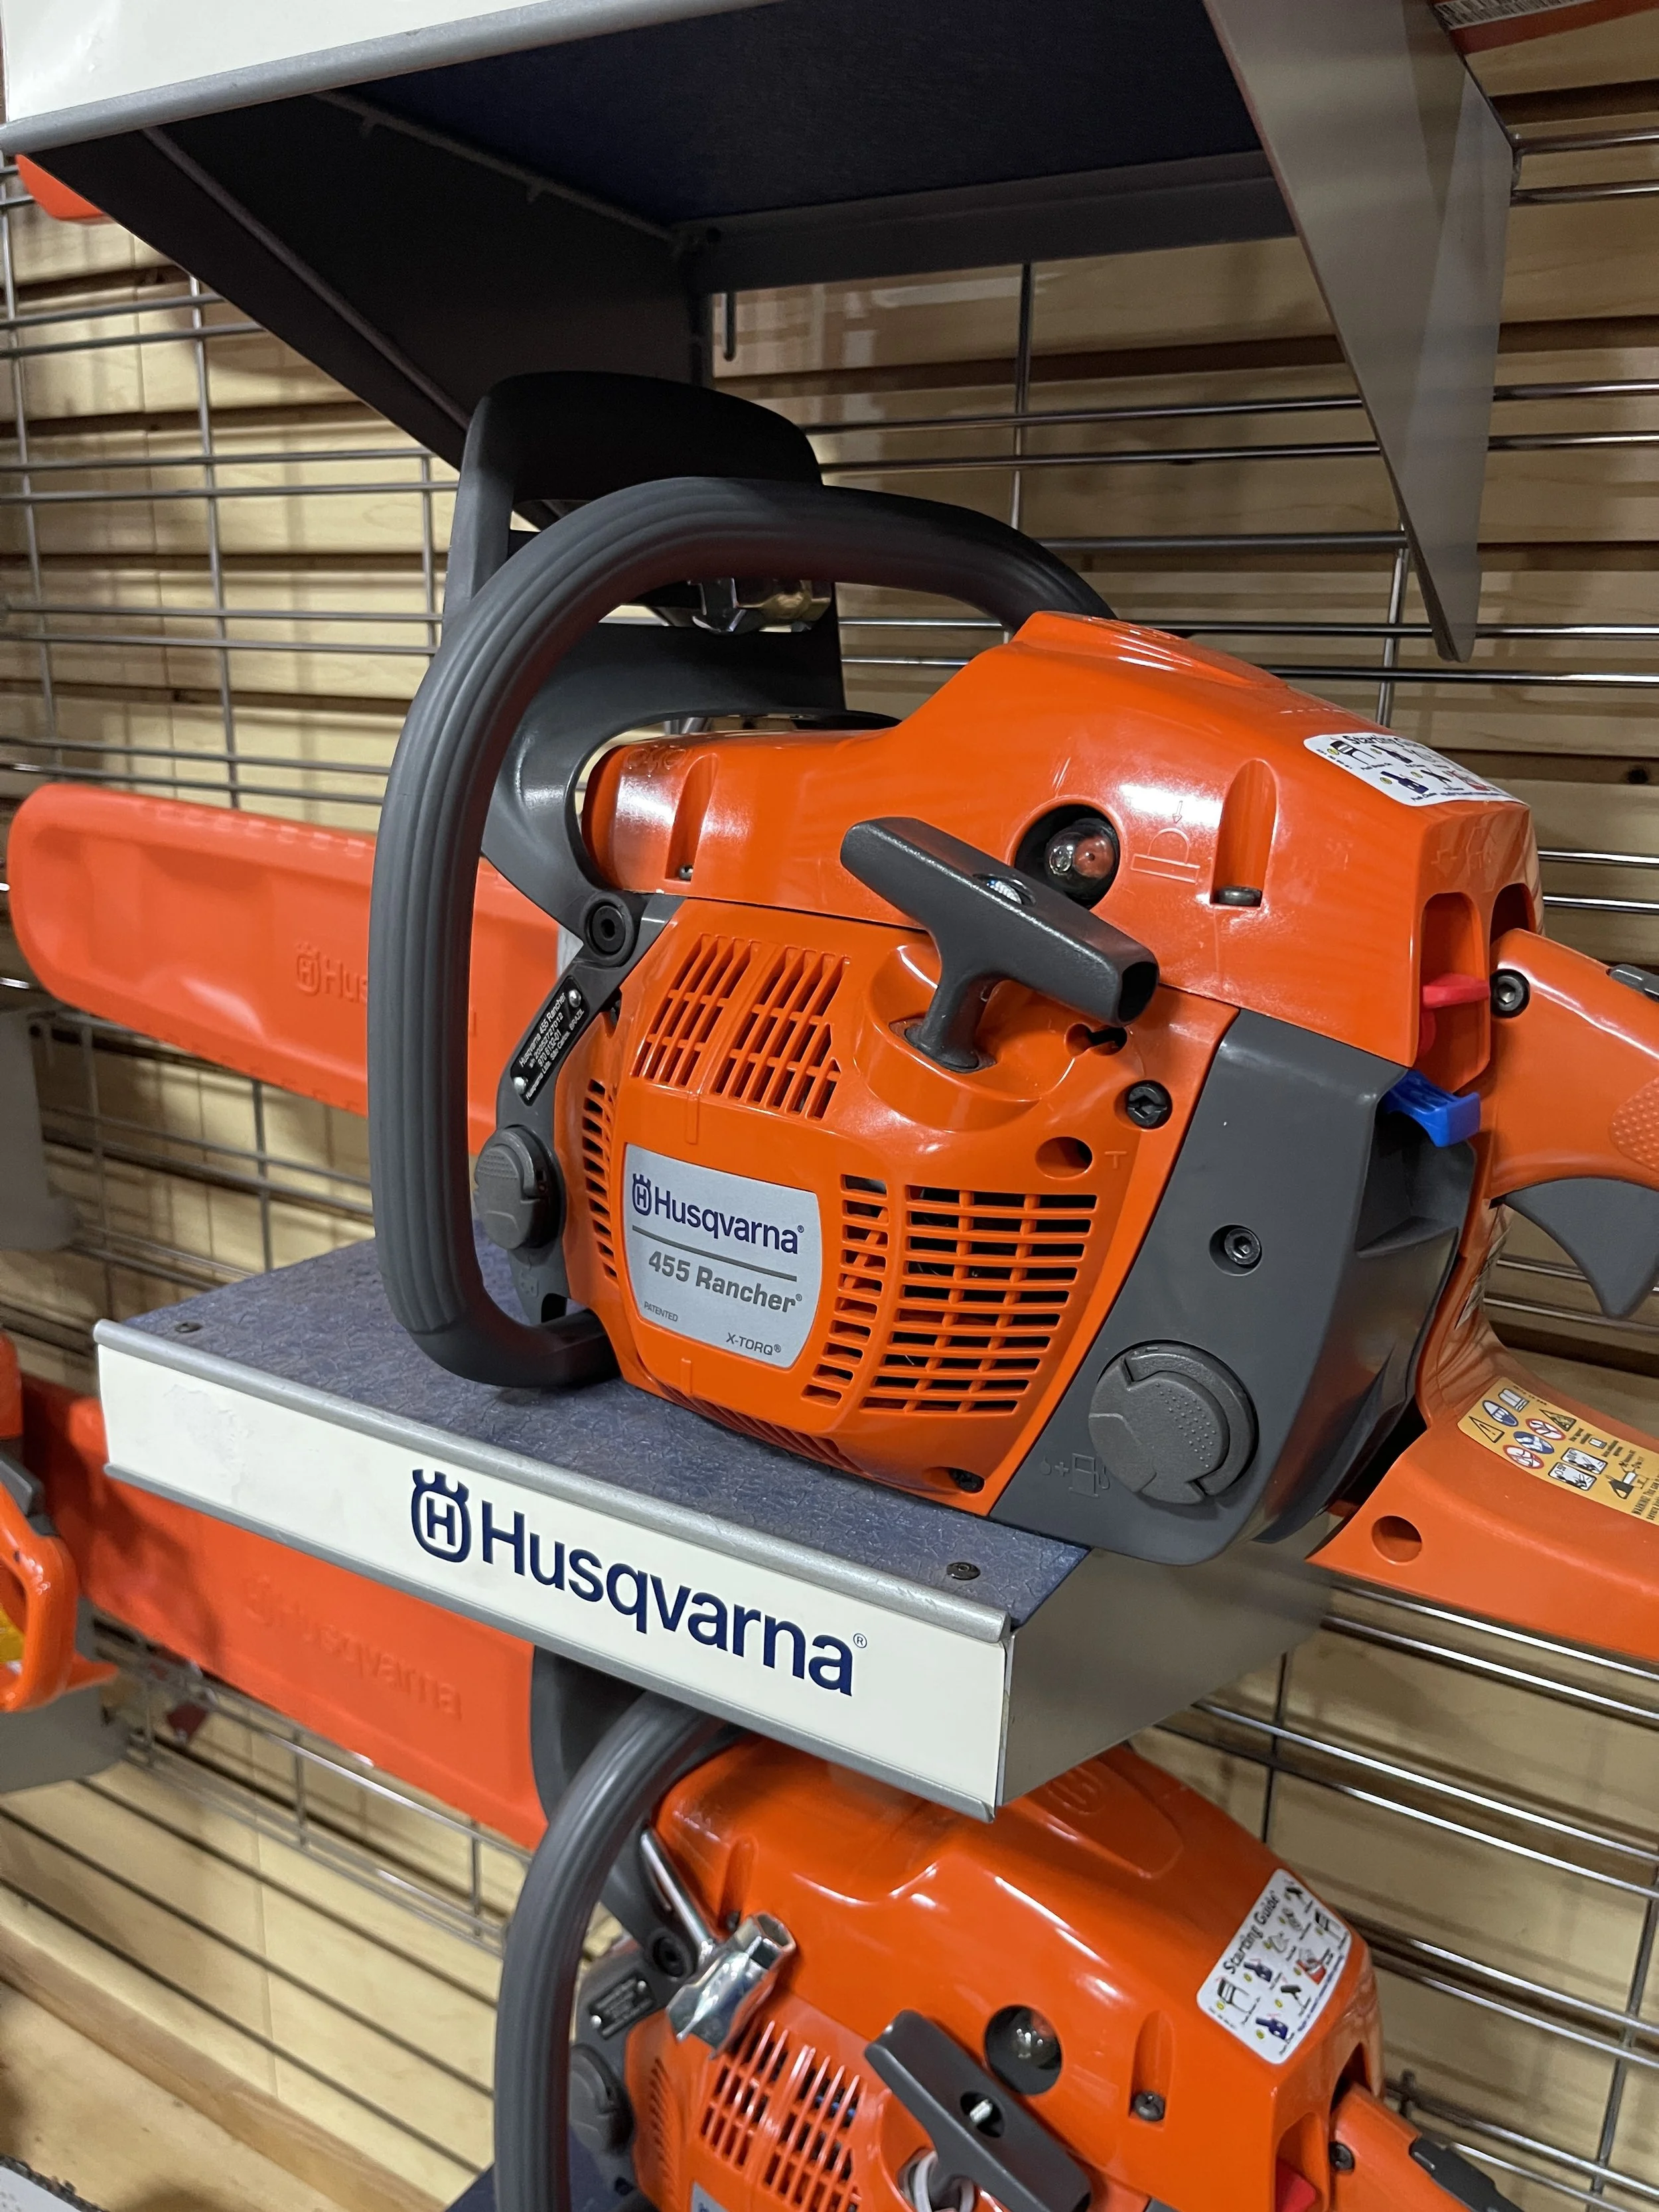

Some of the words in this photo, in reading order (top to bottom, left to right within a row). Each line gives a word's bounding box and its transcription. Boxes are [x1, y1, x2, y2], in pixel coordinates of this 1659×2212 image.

[519, 1033, 542, 1068] Husqvarna
[540, 1019, 549, 1035] 455
[546, 992, 567, 1023] Rancher
[526, 1072, 544, 1100] Husqvarna
[569, 1008, 585, 1031] BRAZIL
[538, 1053, 547, 1067] 970
[648, 1250, 690, 1282] 455
[644, 1301, 678, 1322] PATENTED
[1223, 1925, 1263, 1975] Starting
